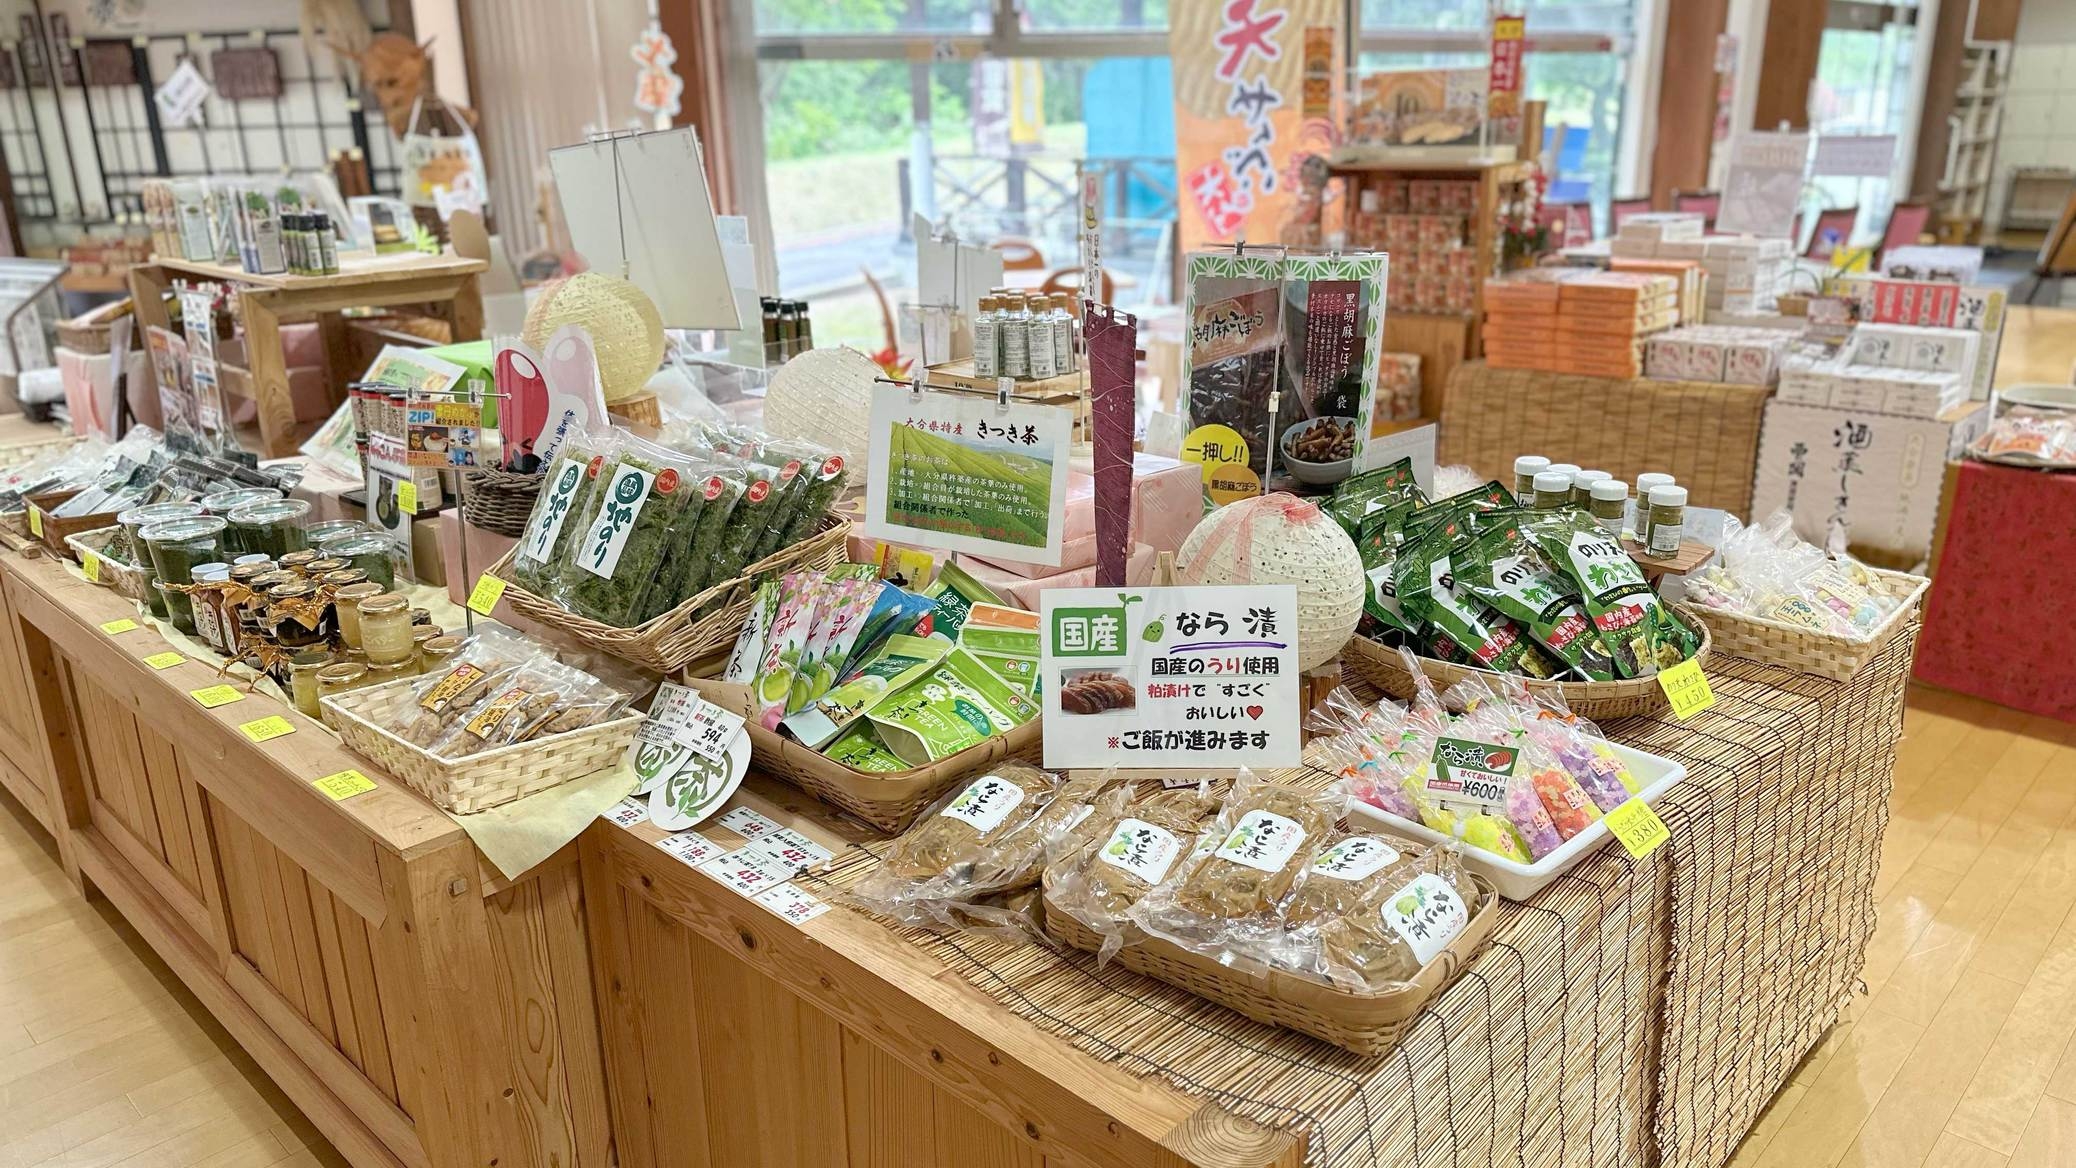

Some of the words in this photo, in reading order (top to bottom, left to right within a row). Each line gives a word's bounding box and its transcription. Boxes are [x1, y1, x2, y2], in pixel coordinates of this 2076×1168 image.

[1340, 293, 1355, 379] 黒胡麻ごぼう
[409, 411, 434, 423] ZIP!
[904, 417, 964, 436] 大分県特産
[977, 419, 1039, 446] きつき茶
[1187, 441, 1243, 463] 一押し!!
[1212, 479, 1257, 492] 黒胡麻ごぼう
[594, 500, 632, 569] 地のり
[939, 592, 971, 618] 緑茶
[1604, 607, 1633, 620] 国内産
[1059, 614, 1119, 652] 国産
[1151, 656, 1279, 676] 国産のうり使用
[917, 705, 948, 732] GREEN
[1186, 705, 1244, 721] おいしい
[914, 716, 934, 730] TEA
[702, 728, 722, 744] 594
[705, 745, 715, 753] 550
[1439, 741, 1484, 767] なら漬
[782, 849, 807, 862] 432
[737, 870, 762, 883] 432
[789, 902, 810, 914] 378
